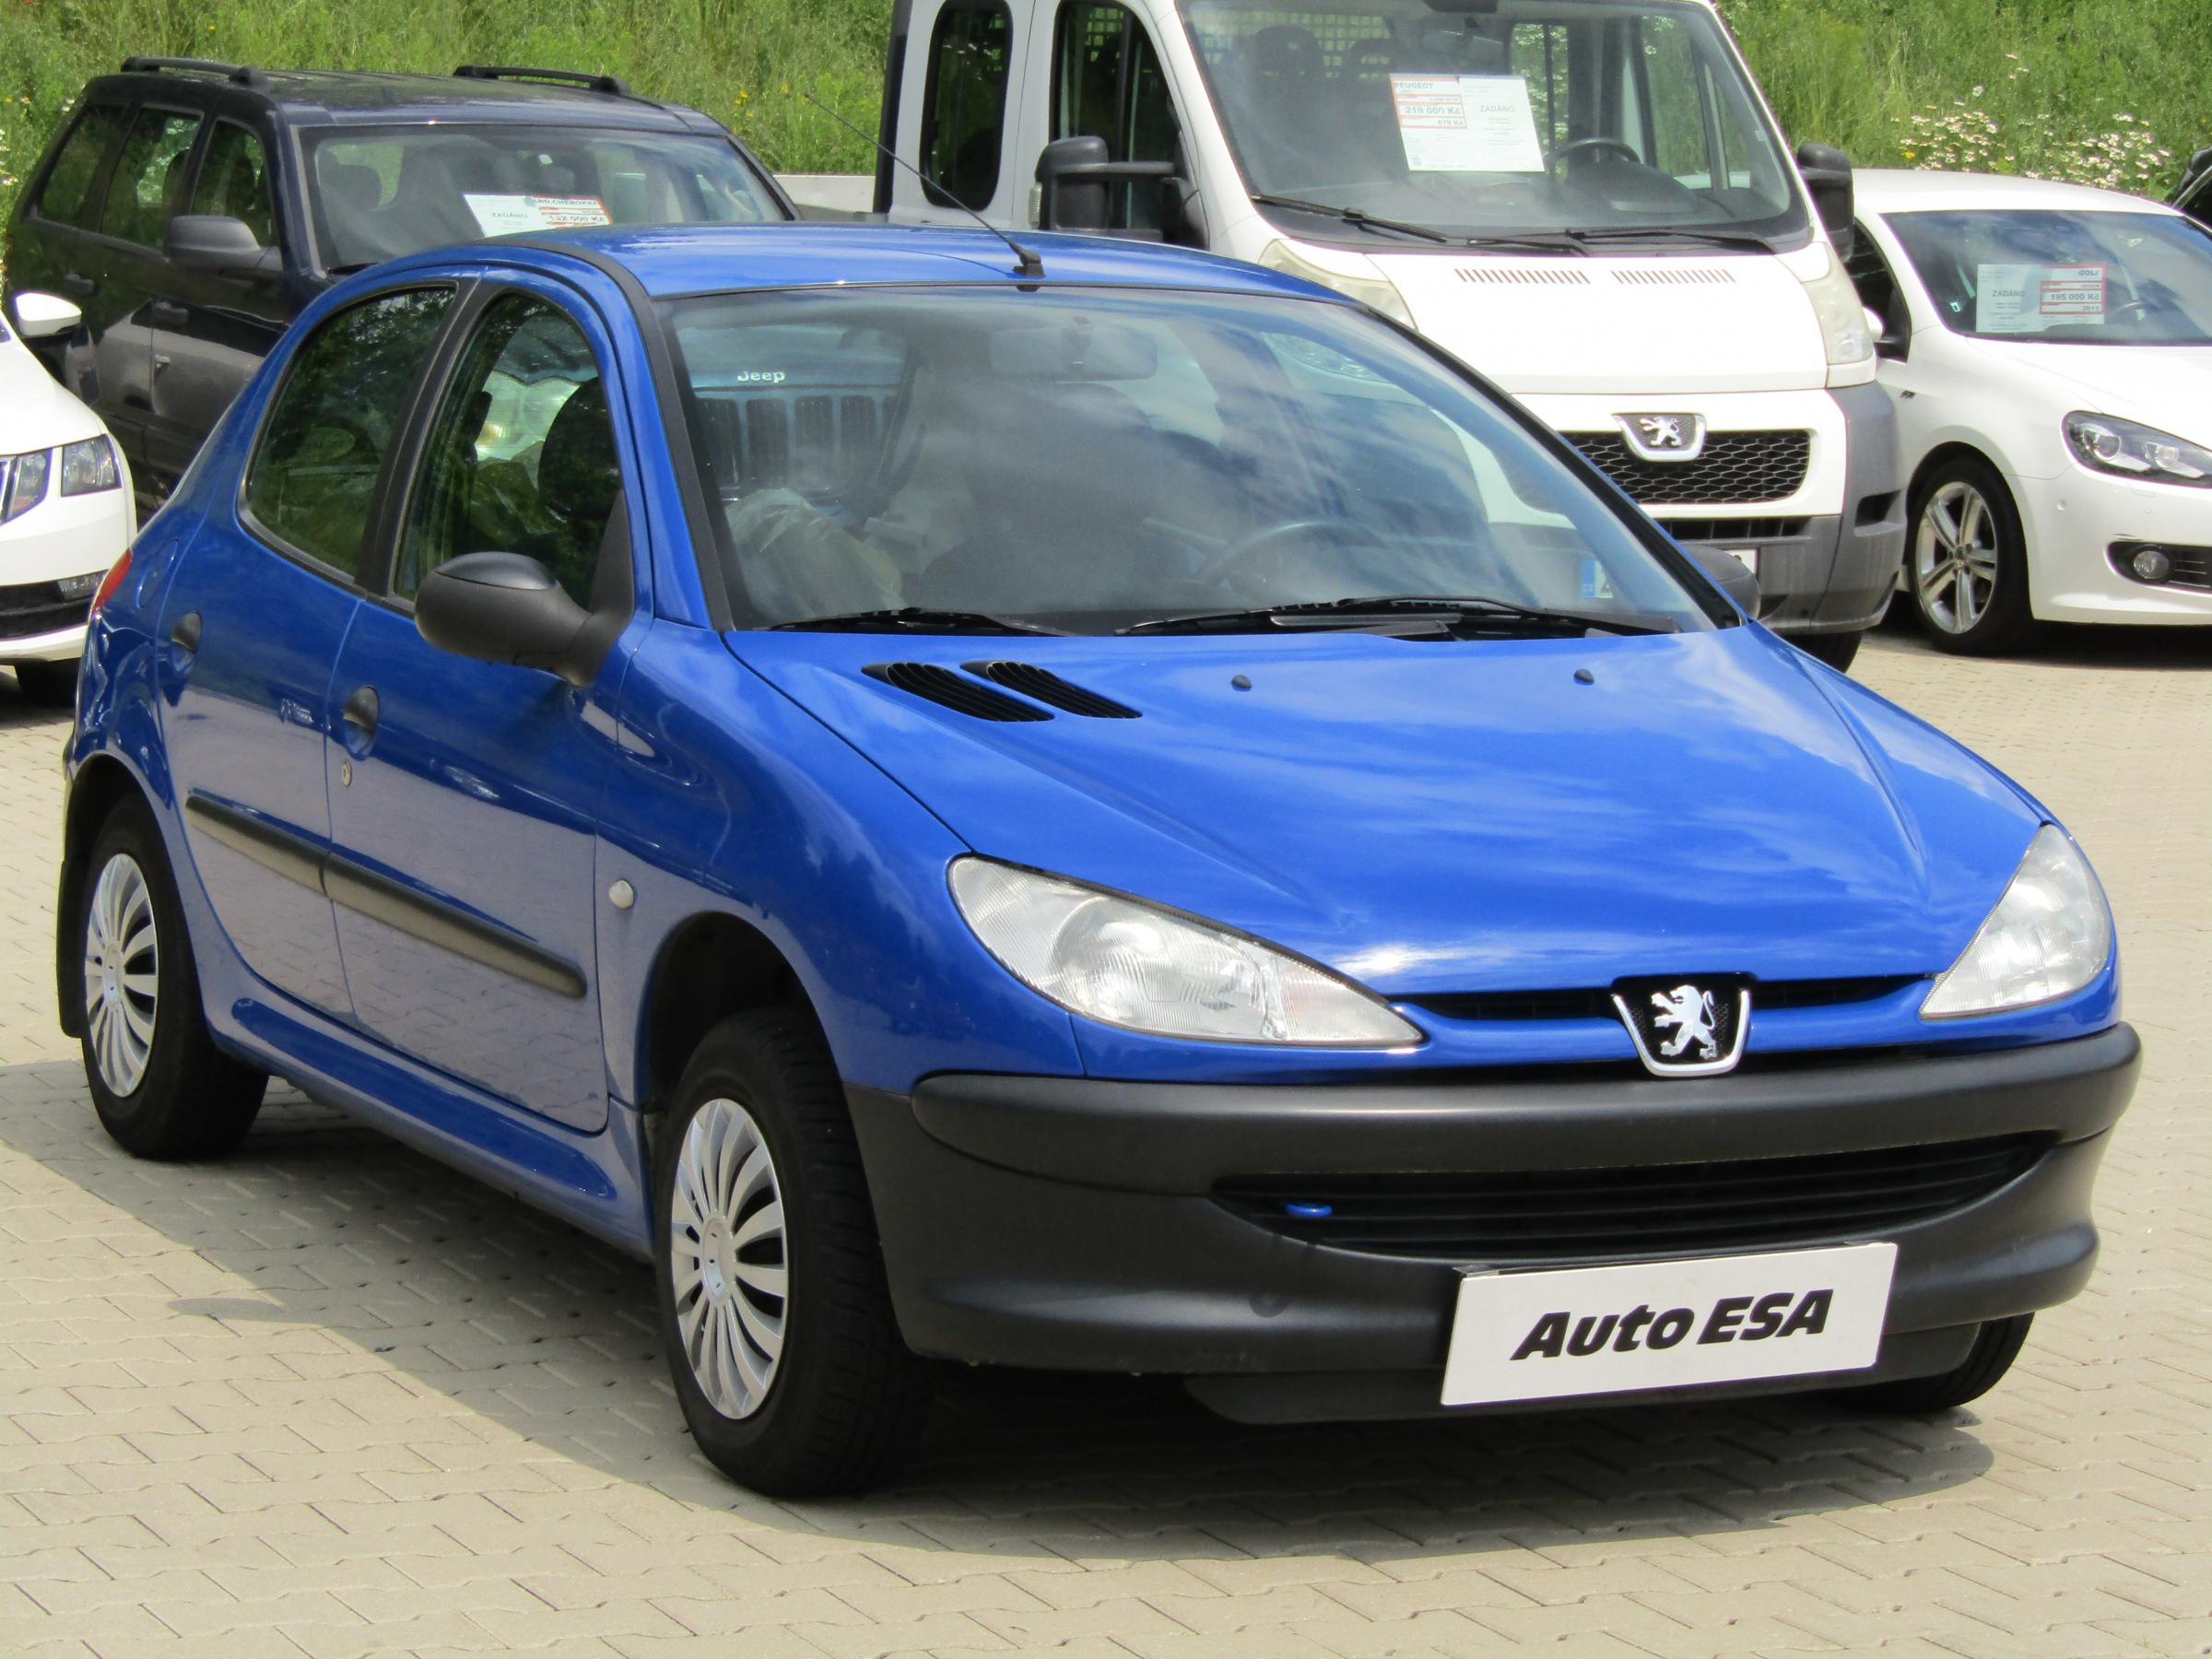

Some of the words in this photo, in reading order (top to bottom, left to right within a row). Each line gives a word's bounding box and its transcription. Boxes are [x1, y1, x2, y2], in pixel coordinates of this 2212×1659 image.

[736, 371, 786, 383] Jeep
[1510, 1304, 1696, 1361] Auto
[1696, 1288, 1834, 1346] ESA
